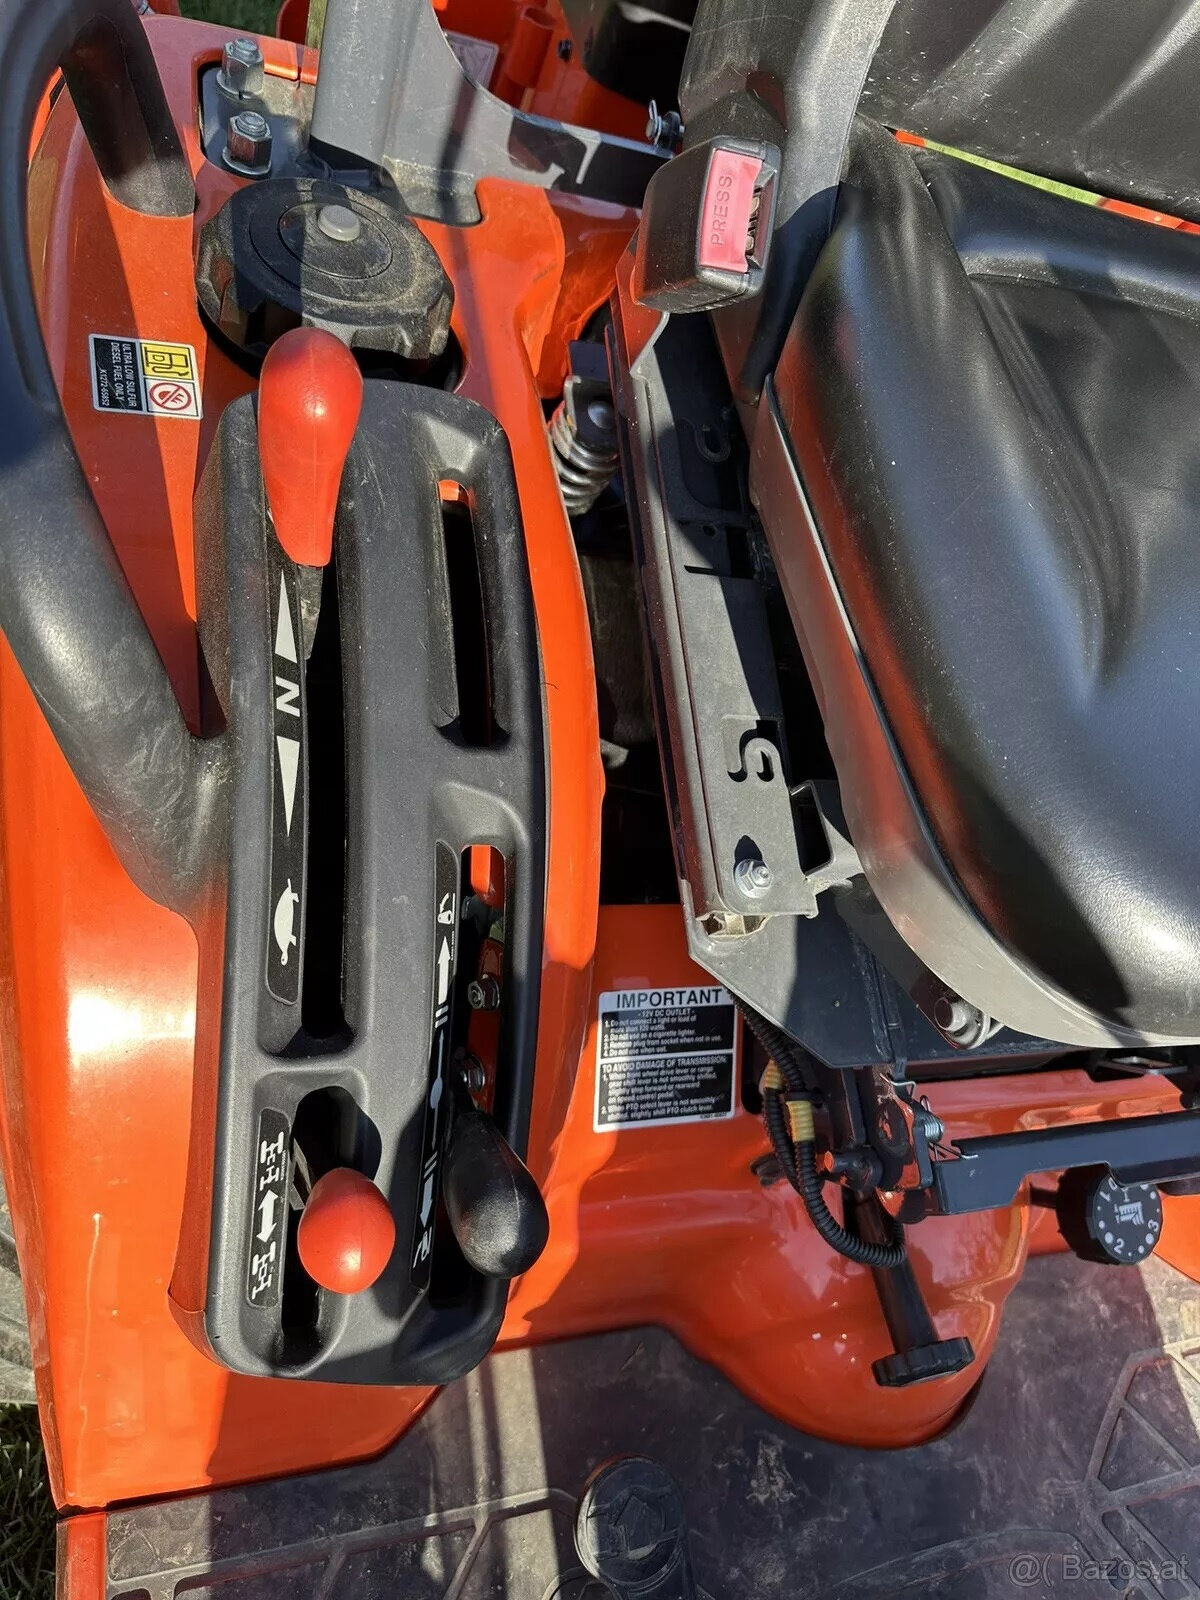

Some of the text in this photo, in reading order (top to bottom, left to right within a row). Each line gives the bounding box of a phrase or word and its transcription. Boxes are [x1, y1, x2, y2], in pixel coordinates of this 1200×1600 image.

[711, 175, 733, 246] PRESS
[111, 342, 124, 401] DIESEL FUEL ONLY
[123, 343, 137, 407] ULTRA LOW SULFUR
[276, 676, 300, 717] N
[616, 988, 722, 1008] IMPORTANT
[665, 1008, 690, 1016] OUTLET
[602, 1064, 612, 1072] TO
[613, 1062, 634, 1071] AVOID
[636, 1060, 664, 1069] DAMAGE
[666, 1059, 676, 1067] OF
[626, 1103, 638, 1111] PTO
[1148, 1219, 1159, 1232] 3
[1114, 1238, 1124, 1254] 2
